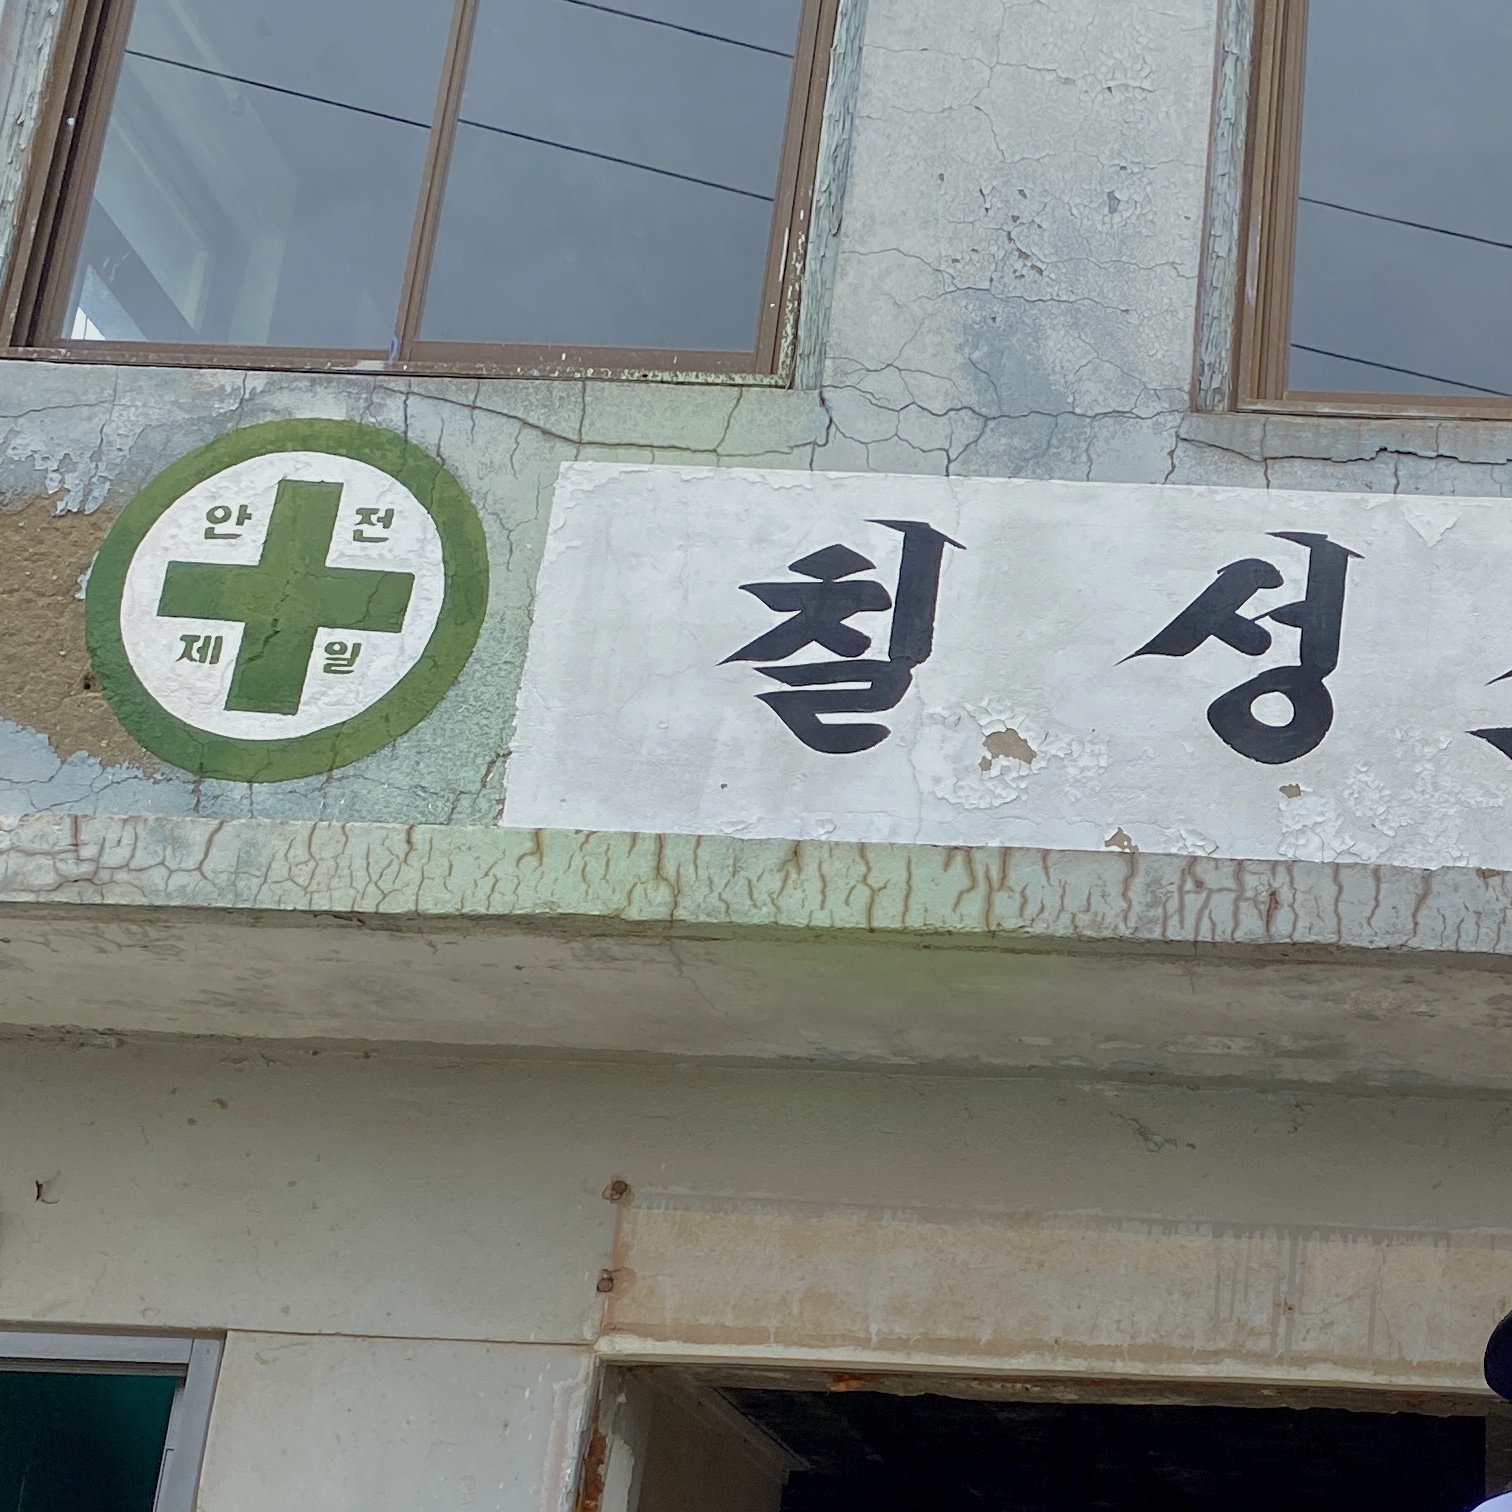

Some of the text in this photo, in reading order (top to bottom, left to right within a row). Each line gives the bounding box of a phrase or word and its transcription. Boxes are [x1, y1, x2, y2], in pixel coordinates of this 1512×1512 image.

[204, 504, 394, 542] 안 전
[175, 634, 362, 675] 제 일
